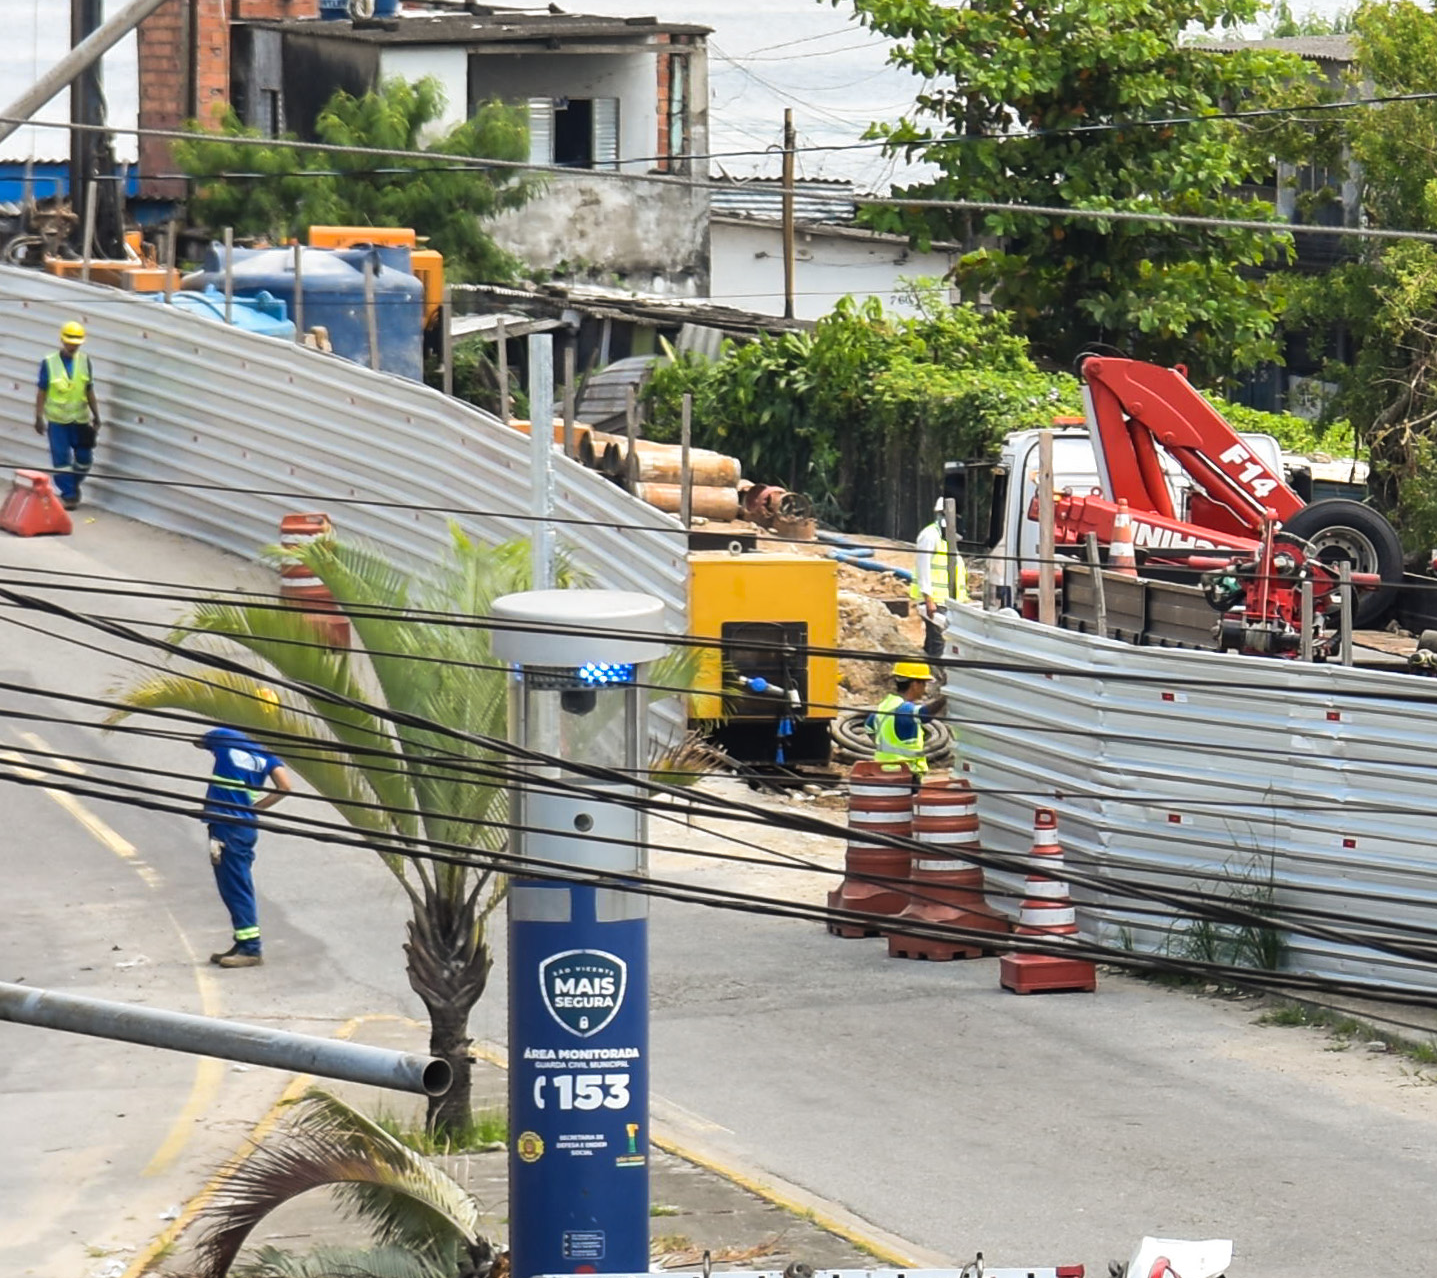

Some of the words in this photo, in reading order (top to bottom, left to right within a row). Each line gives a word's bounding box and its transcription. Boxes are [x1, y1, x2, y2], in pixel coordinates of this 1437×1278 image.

[1219, 443, 1278, 498] F14
[575, 966, 616, 977] VICENTE
[554, 977, 615, 996] MAIS
[554, 996, 614, 1009] SEGURA
[523, 1047, 557, 1060] ÁREA
[558, 1047, 640, 1060] MONITORADA
[534, 1061, 567, 1069] GUARDA
[553, 1073, 631, 1111] 153
